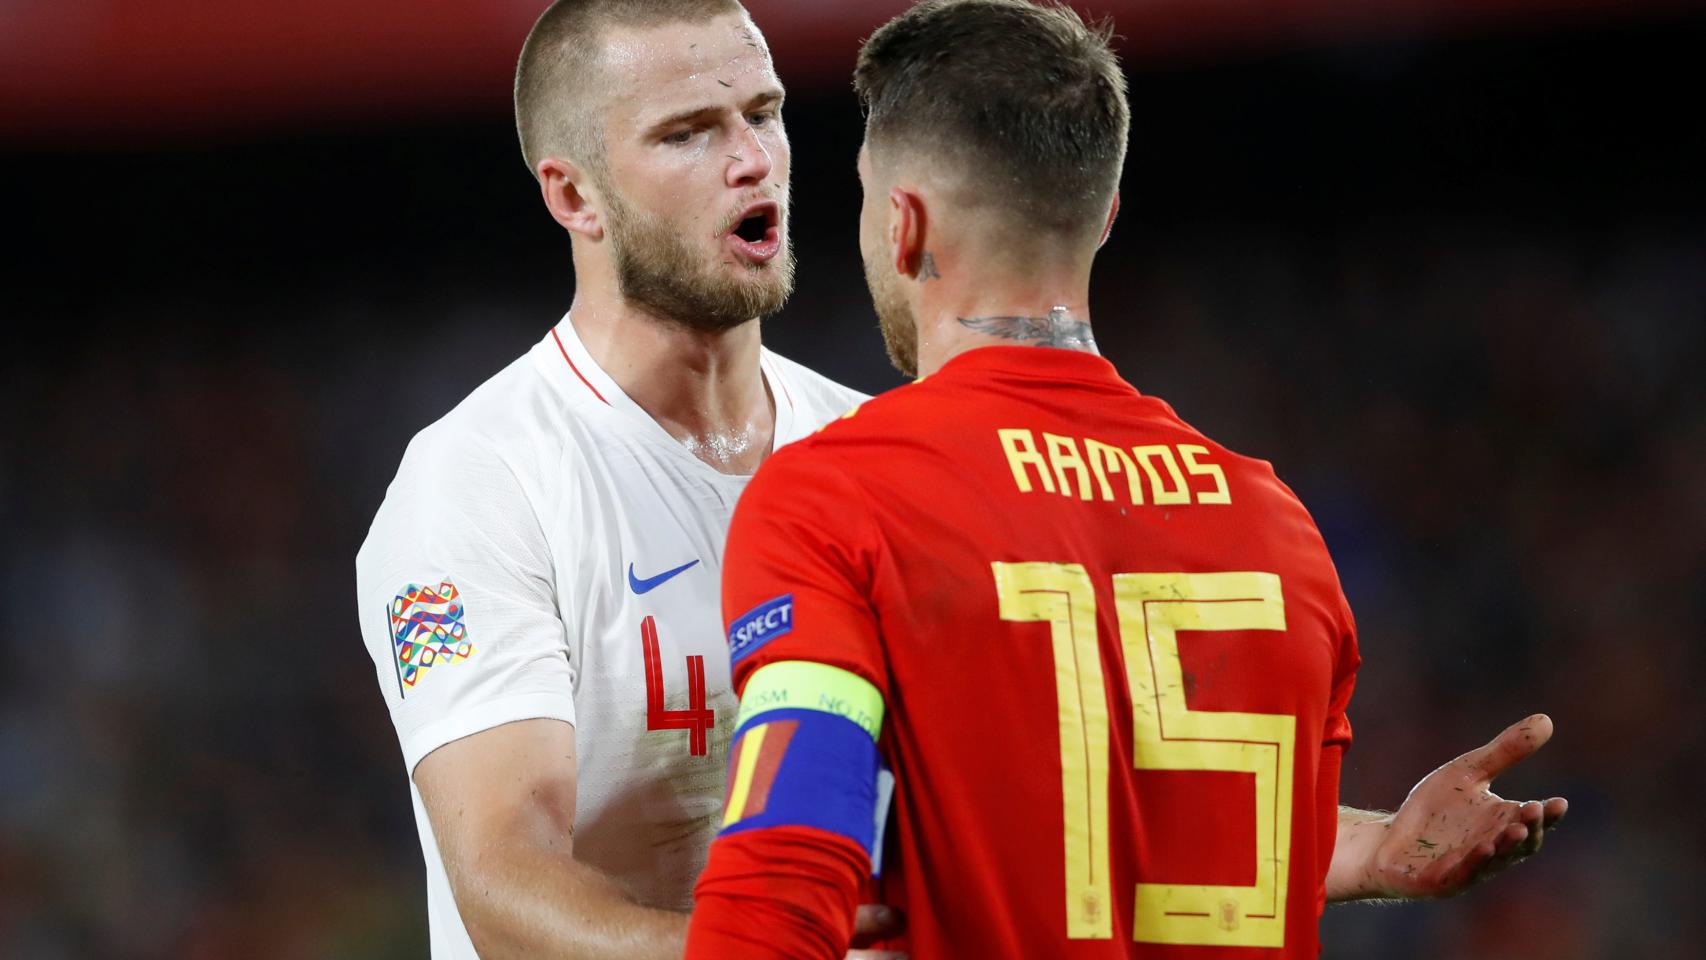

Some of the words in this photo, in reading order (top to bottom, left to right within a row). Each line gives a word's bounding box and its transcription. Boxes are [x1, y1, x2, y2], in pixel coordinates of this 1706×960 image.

[997, 429, 1232, 505] RAMOS
[640, 615, 714, 756] 4
[819, 693, 851, 715] NO
[991, 561, 1297, 948] 15
